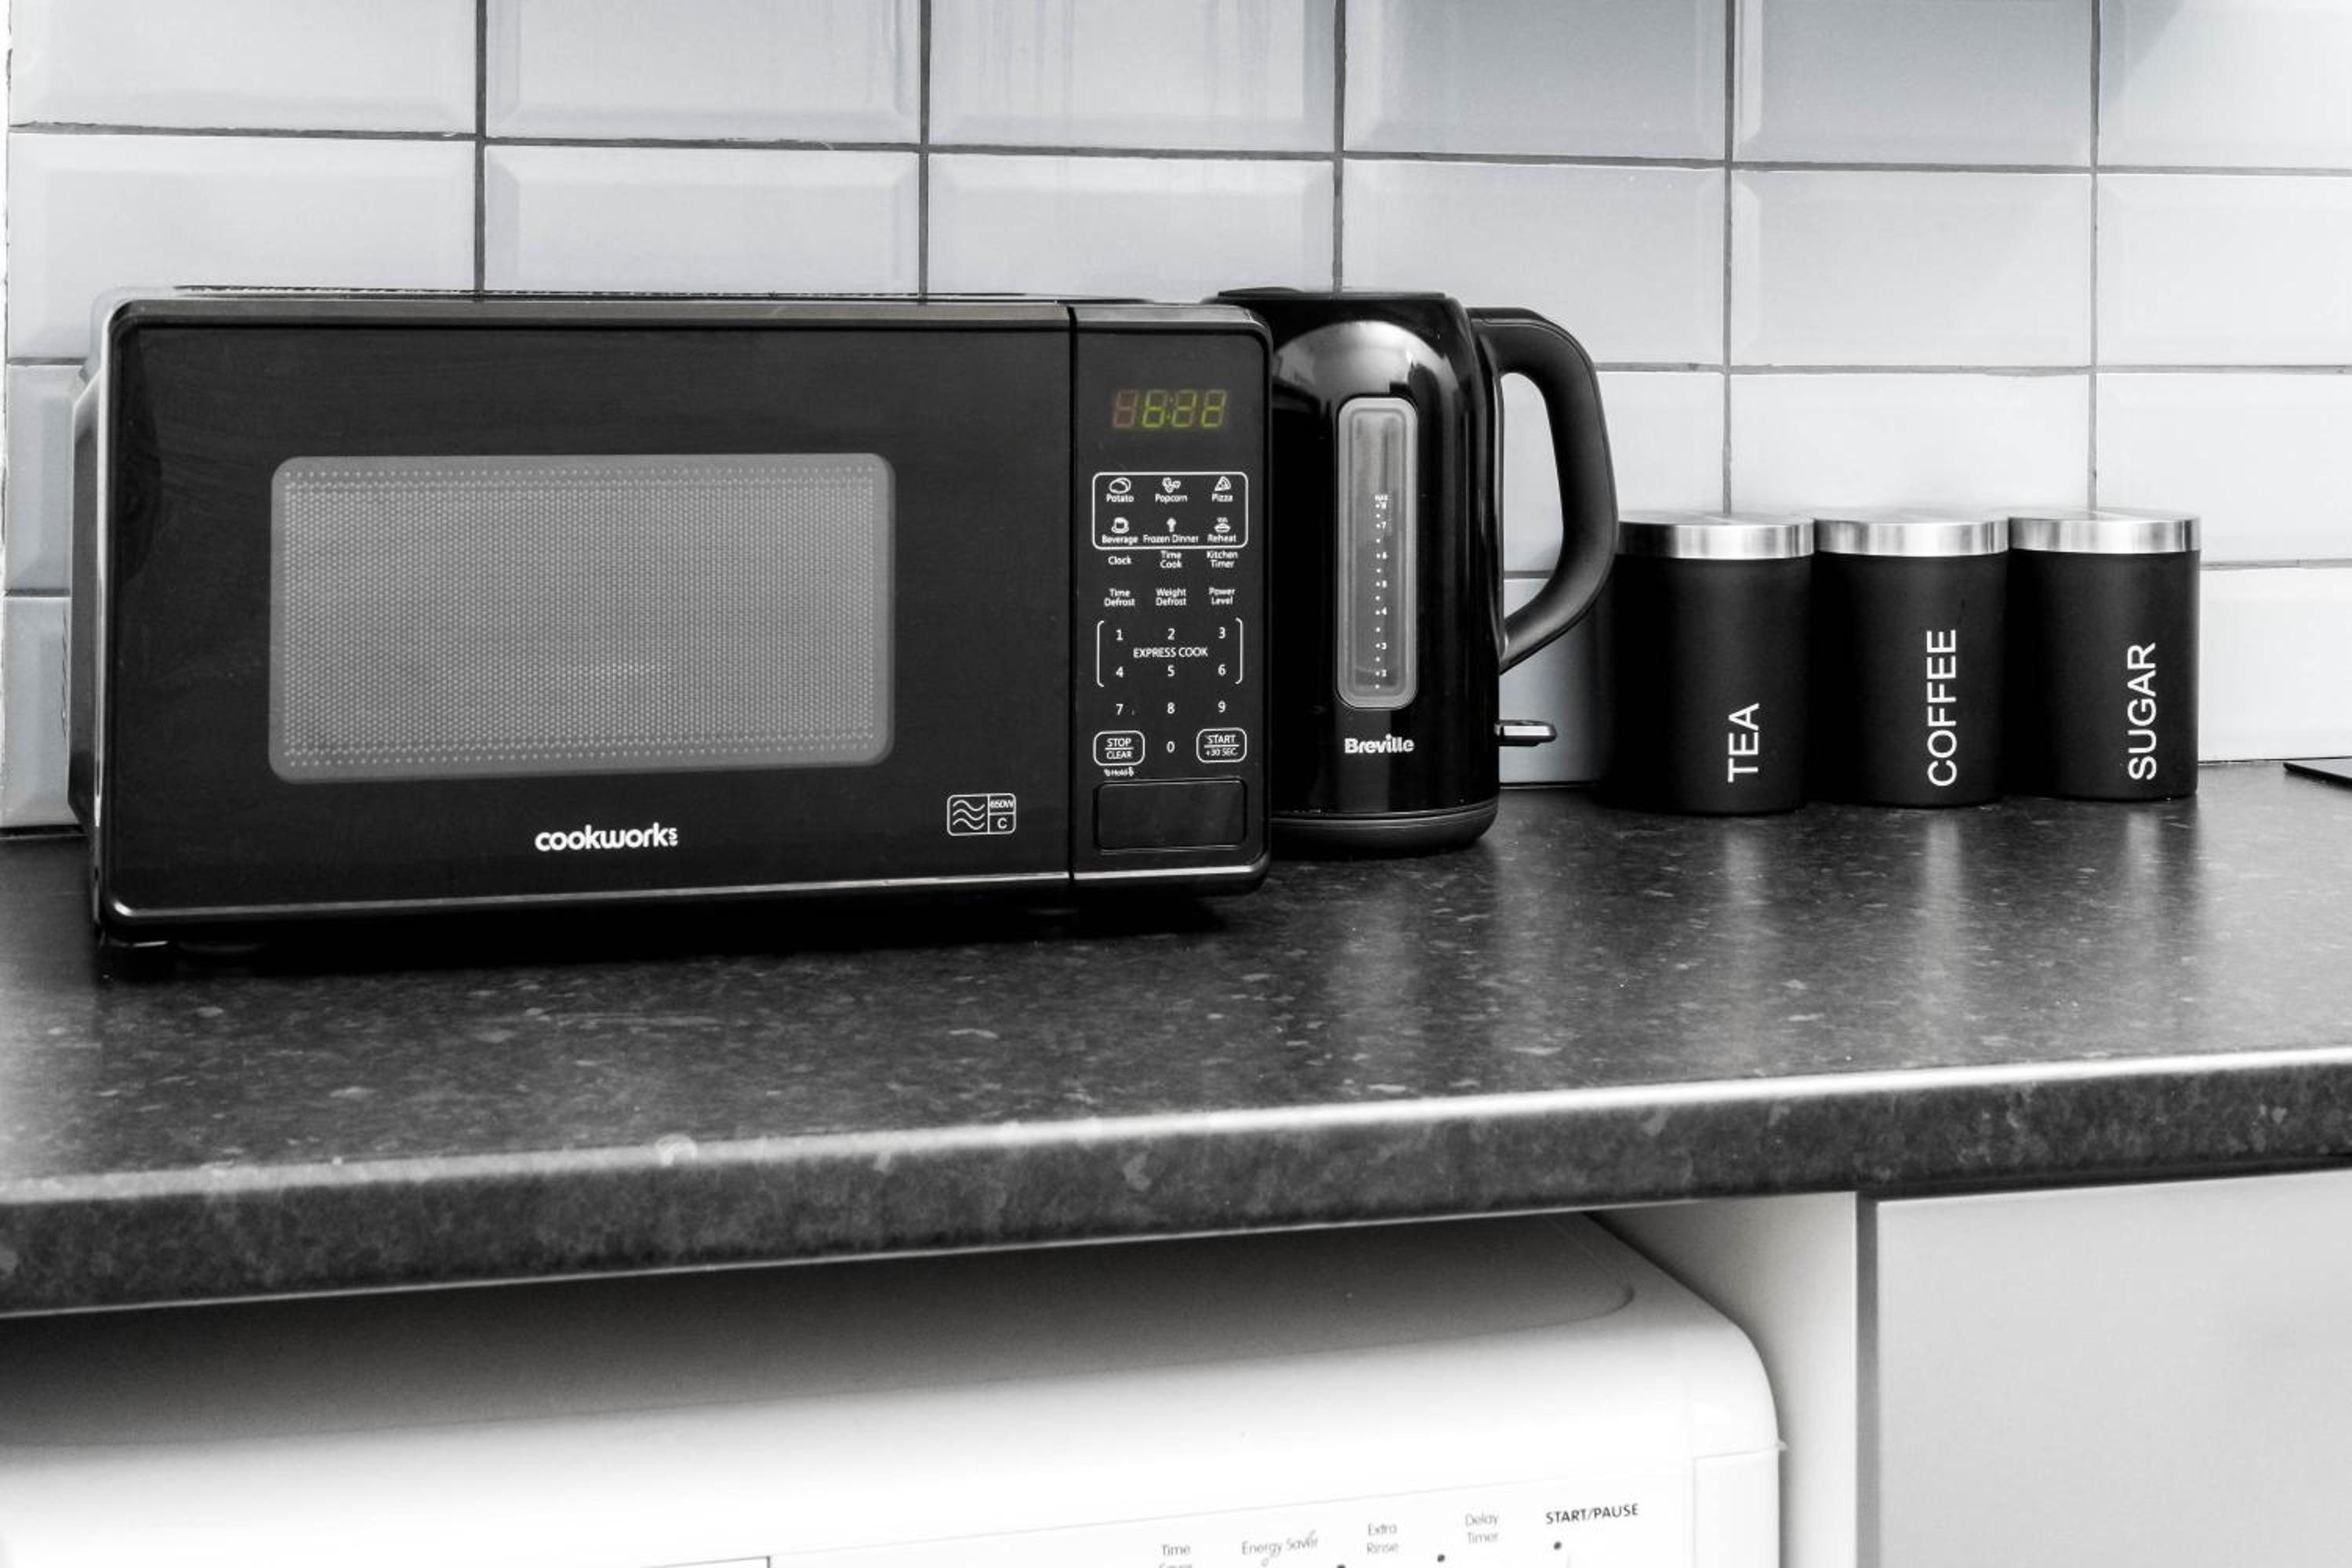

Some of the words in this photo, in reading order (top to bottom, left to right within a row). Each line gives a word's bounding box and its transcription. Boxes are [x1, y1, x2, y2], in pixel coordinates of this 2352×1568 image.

[1106, 494, 1134, 503] Potato
[1155, 494, 1188, 504] Popcorn
[1102, 535, 1138, 546] Beverage
[1143, 535, 1171, 543] Frozen
[1171, 535, 1199, 543] Dinner
[1207, 535, 1236, 543] Reheat
[1108, 556, 1132, 565] Clock
[1160, 550, 1181, 559] Time
[1207, 550, 1239, 559] Kitchen
[1160, 559, 1182, 568] Cook
[1210, 559, 1235, 568] Timer
[1109, 588, 1131, 597] Time
[1156, 588, 1187, 598] Weight
[1208, 587, 1236, 596] Power
[1104, 597, 1135, 606] Defrost
[1156, 597, 1187, 606] Defrost
[1211, 596, 1233, 605] Level
[1116, 629, 1123, 641] 1
[1167, 628, 1175, 641] 2
[1218, 626, 1226, 639] 3
[1133, 647, 1177, 658] EXPRESS
[1178, 646, 1209, 657] COOK
[1116, 666, 1124, 678] 4
[1167, 665, 1175, 677] 5
[1218, 664, 1226, 677] 6
[1116, 703, 1123, 716] 7
[1167, 702, 1175, 714] 8
[1218, 700, 1226, 713] 9
[1926, 630, 1958, 786] COFFEE
[2127, 642, 2157, 781] SUGAR
[1106, 738, 1132, 747] STOP
[1206, 734, 1236, 744] START
[1344, 733, 1415, 753] Breville
[1727, 702, 1760, 782] TEA
[1167, 741, 1175, 753] 0
[1106, 750, 1133, 760] CLEAR
[997, 817, 1007, 829] C
[535, 822, 678, 852] cookworks
[1465, 1512, 1500, 1527] Delay
[1545, 1503, 1639, 1525] START/PAUSE
[1367, 1523, 1398, 1537] Extra
[1467, 1530, 1499, 1544] Timer
[1161, 1544, 1192, 1556] Time
[1241, 1540, 1283, 1558] Energy
[1367, 1541, 1399, 1555] Rinse
